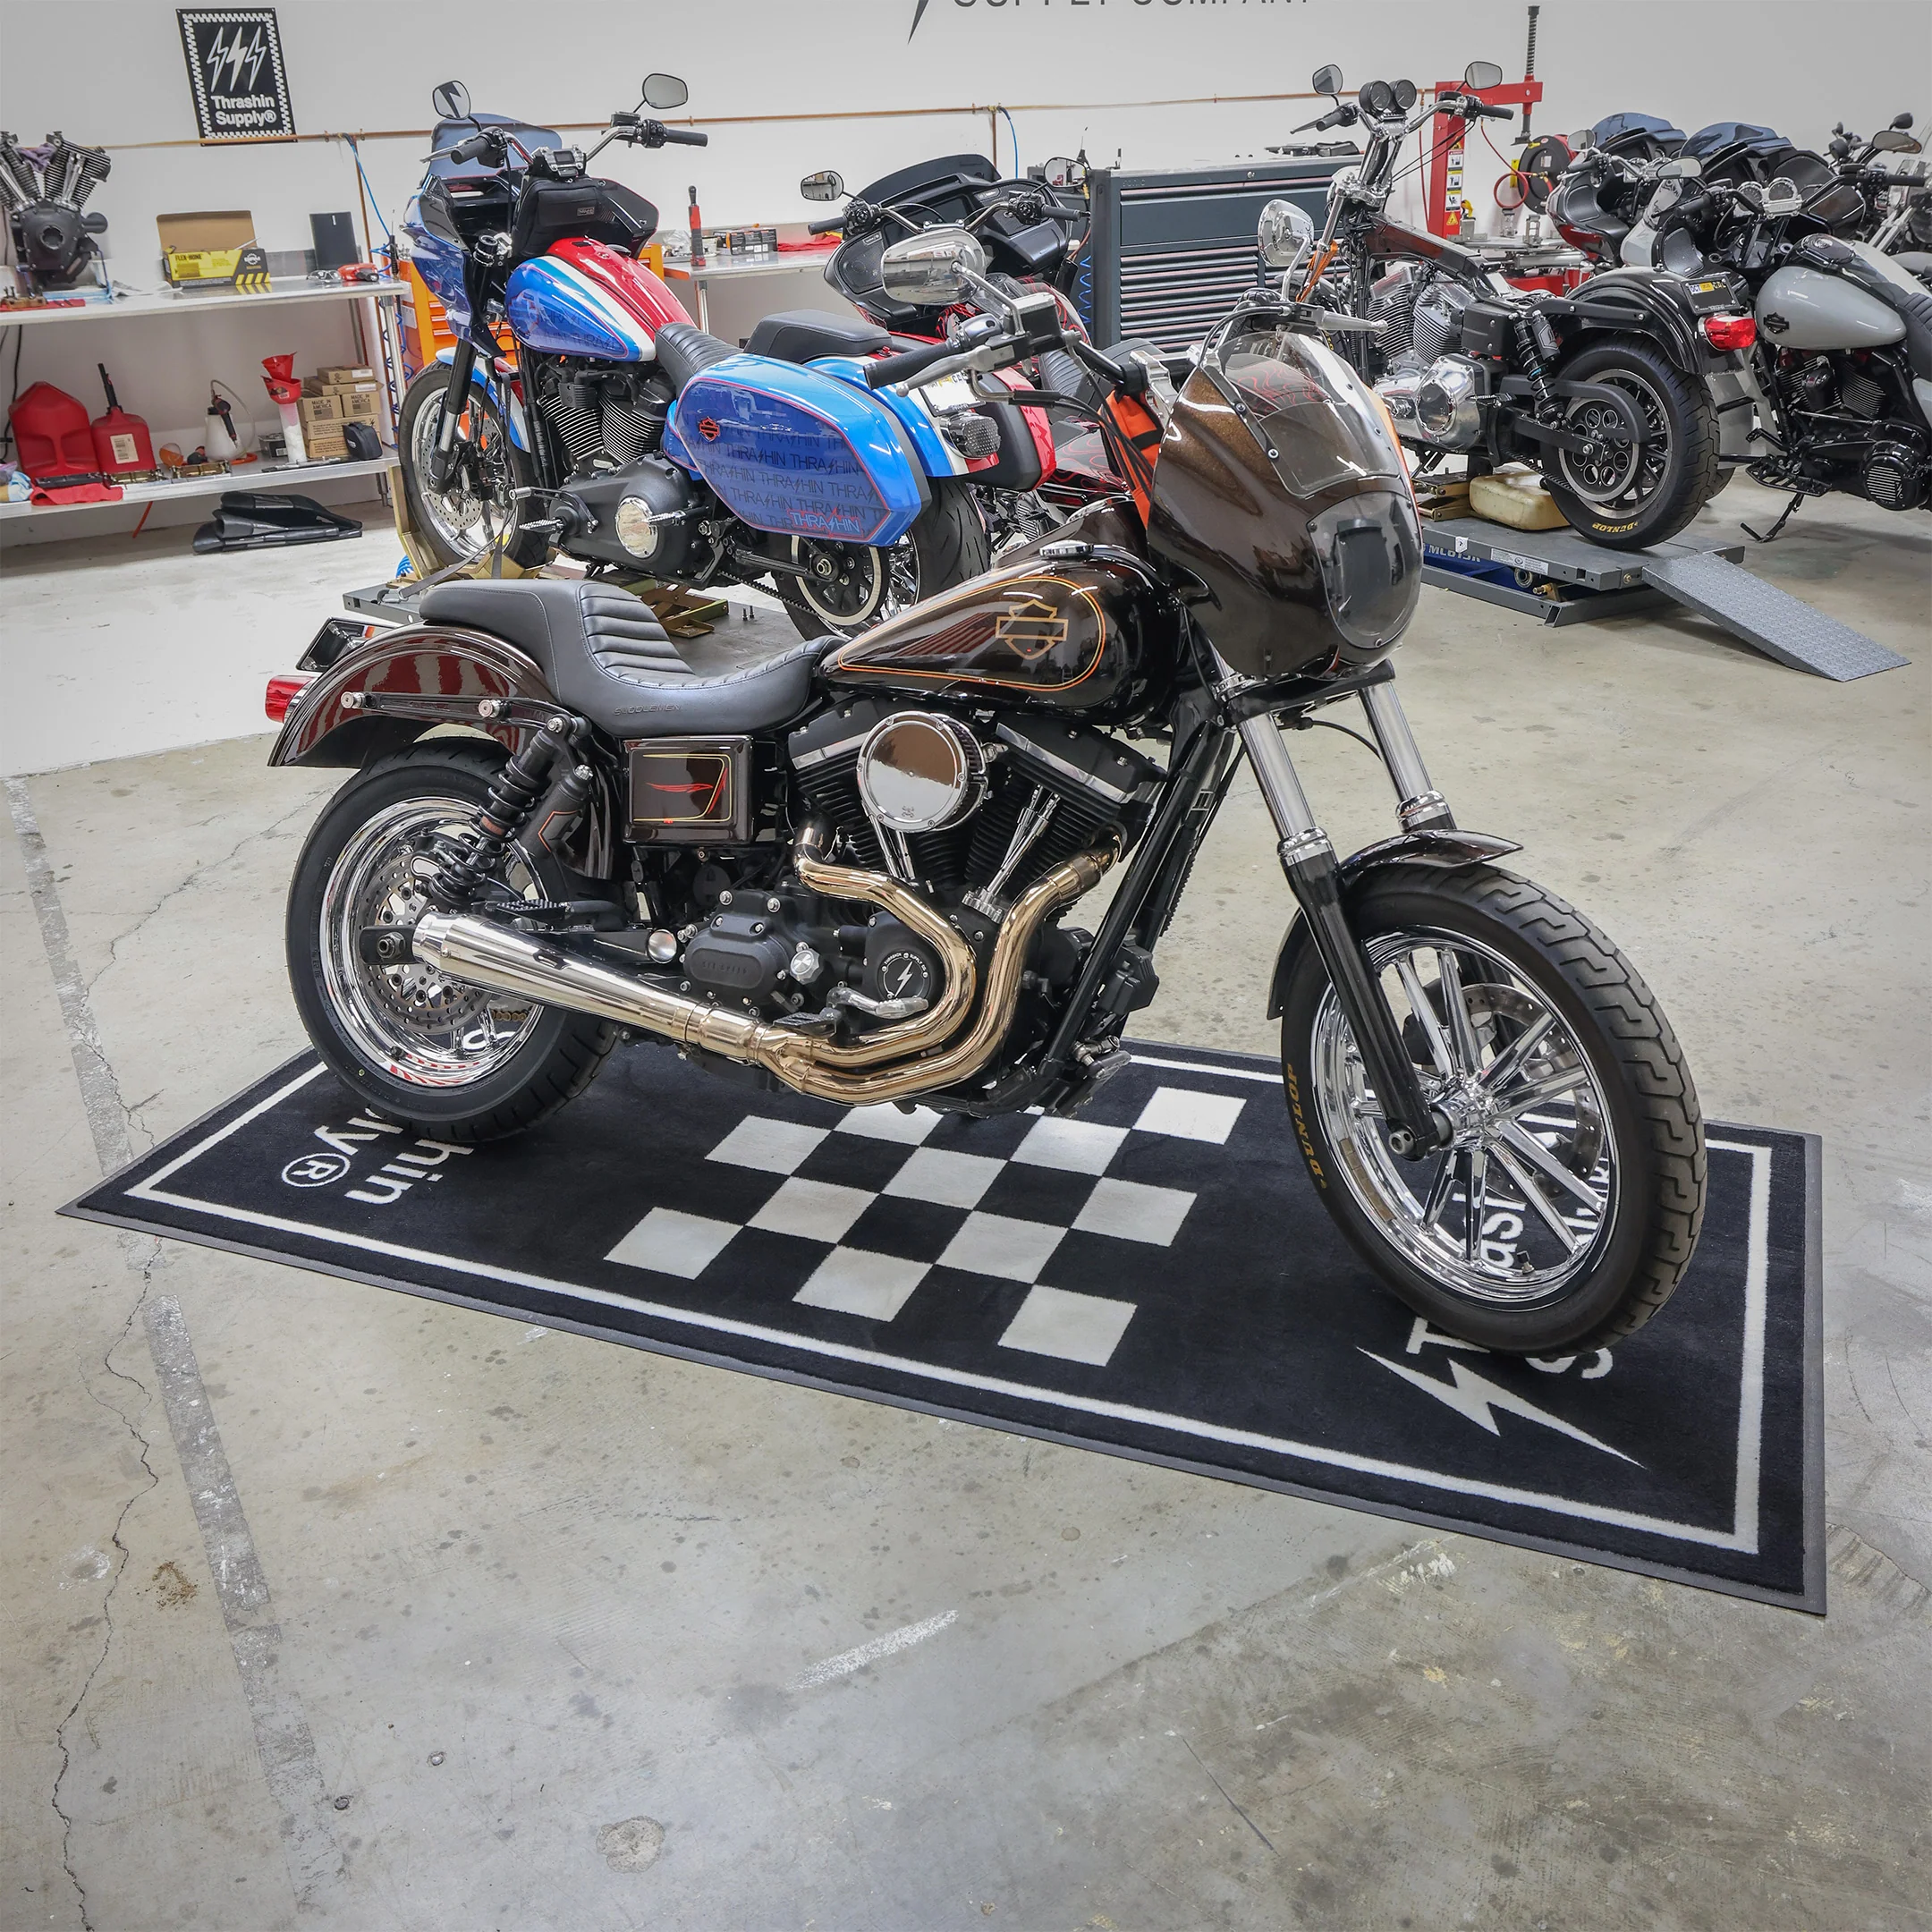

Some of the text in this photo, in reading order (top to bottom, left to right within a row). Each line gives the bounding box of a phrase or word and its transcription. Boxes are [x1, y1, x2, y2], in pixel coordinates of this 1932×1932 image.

[210, 94, 275, 109] Thrashin
[215, 109, 276, 127] Supply®
[1592, 522, 1635, 533] DUNLOP
[1287, 1063, 1324, 1177] DUNLOP
